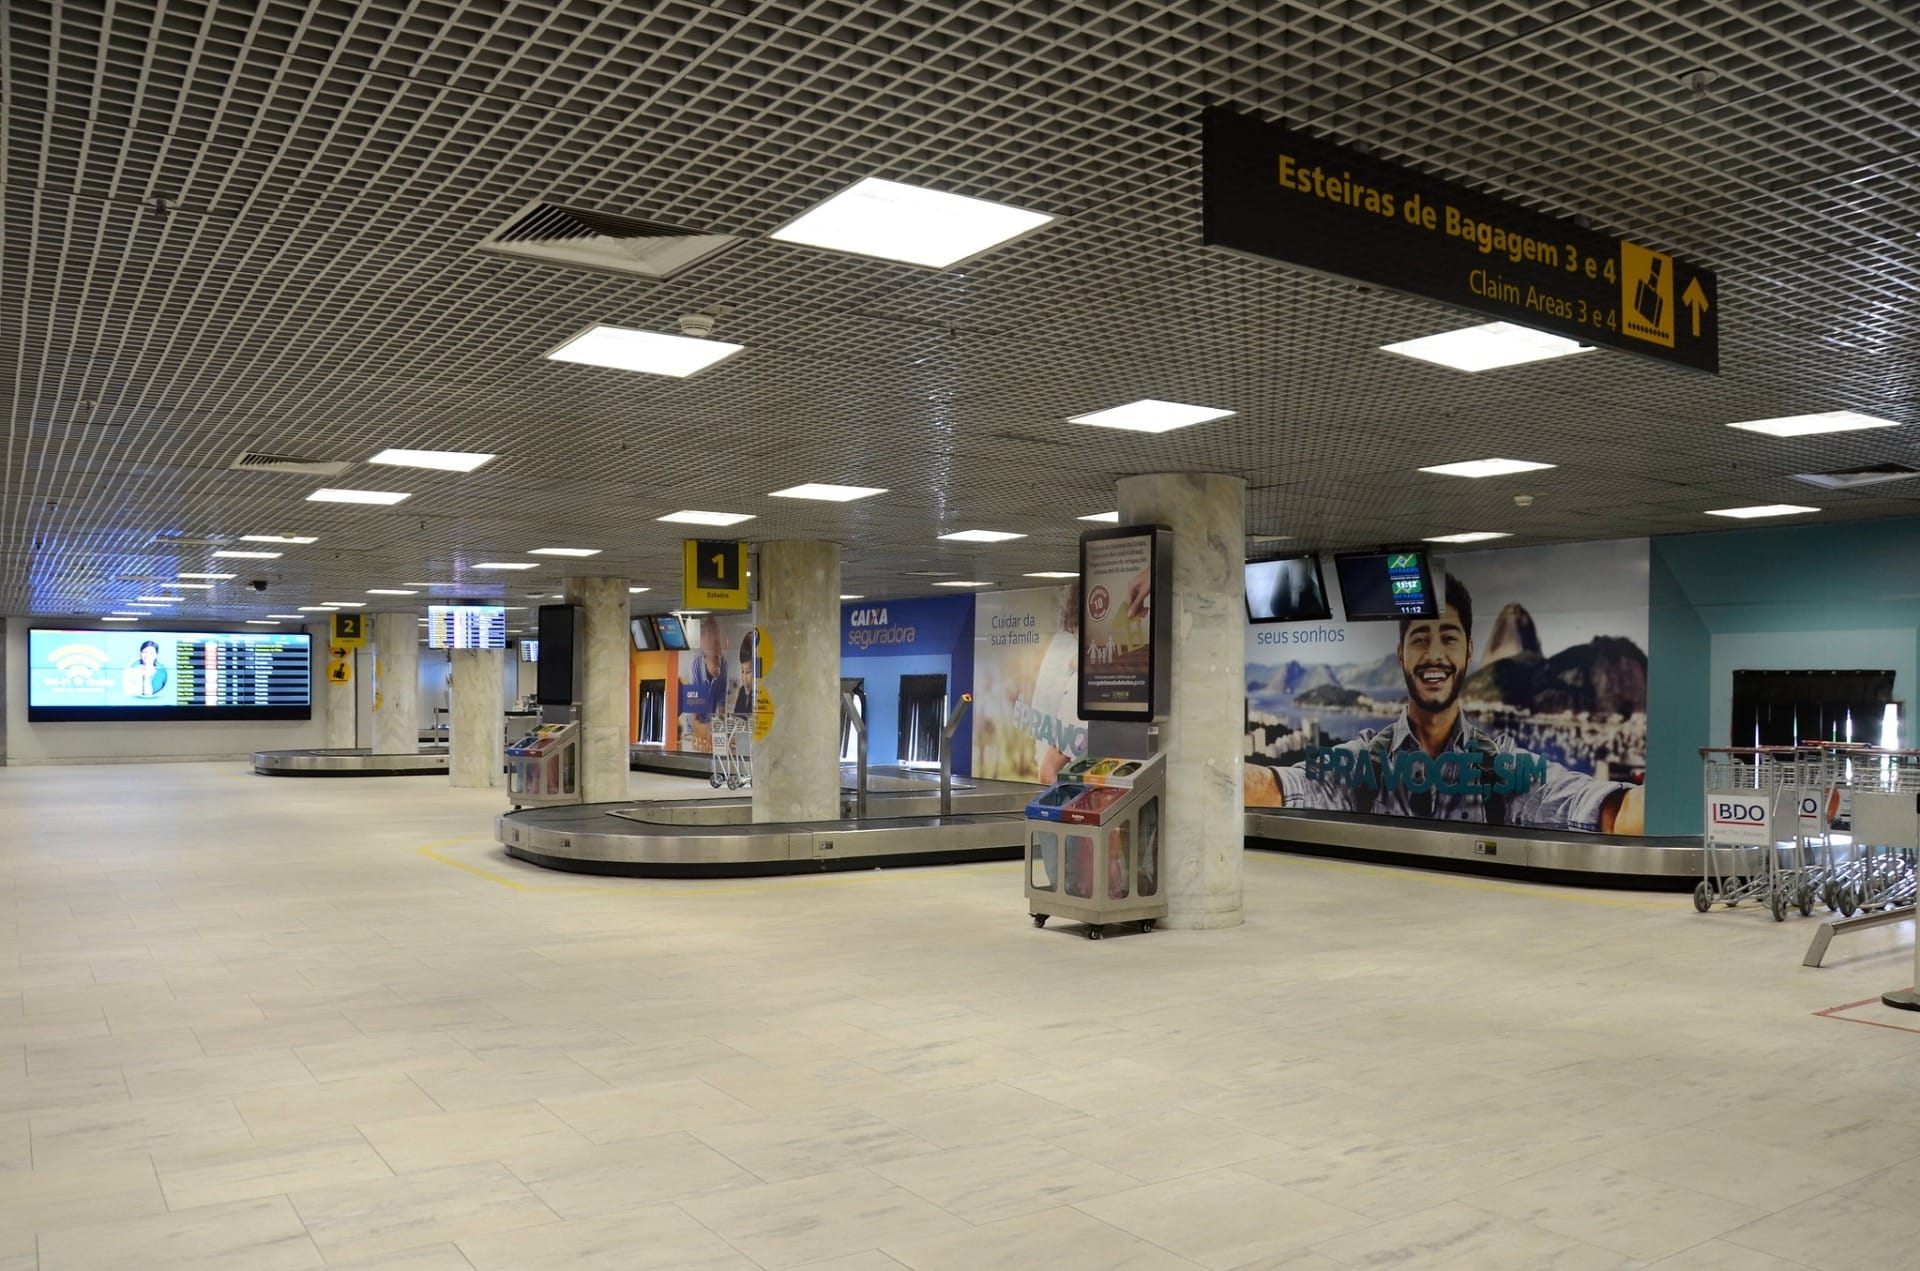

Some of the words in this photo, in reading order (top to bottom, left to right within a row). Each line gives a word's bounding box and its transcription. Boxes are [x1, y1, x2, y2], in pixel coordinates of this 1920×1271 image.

[1278, 154, 1395, 218] Esteiras
[1404, 193, 1437, 230] de
[1445, 205, 1558, 268] Bagagem
[1565, 245, 1577, 272] 3
[1585, 256, 1598, 280] e
[1603, 257, 1616, 285] 4
[1469, 269, 1520, 305] Claim
[1525, 283, 1572, 322] Areas
[1577, 300, 1587, 324] 3
[1593, 308, 1602, 328] e
[1606, 309, 1617, 332] 4
[711, 553, 725, 580] 1
[850, 608, 888, 627] CAIXA
[1401, 606, 1422, 614] 11:12
[343, 619, 354, 633] 2
[991, 614, 1021, 629] Cuidar
[1024, 612, 1036, 627] da
[848, 623, 916, 650] seguradora
[991, 634, 1006, 646] sua
[1008, 630, 1040, 646] família
[1257, 631, 1288, 645] seus
[1292, 625, 1345, 644] sonhos
[1318, 746, 1377, 791] PRA
[1492, 753, 1547, 794] SIM
[1719, 803, 1765, 821] BDO
